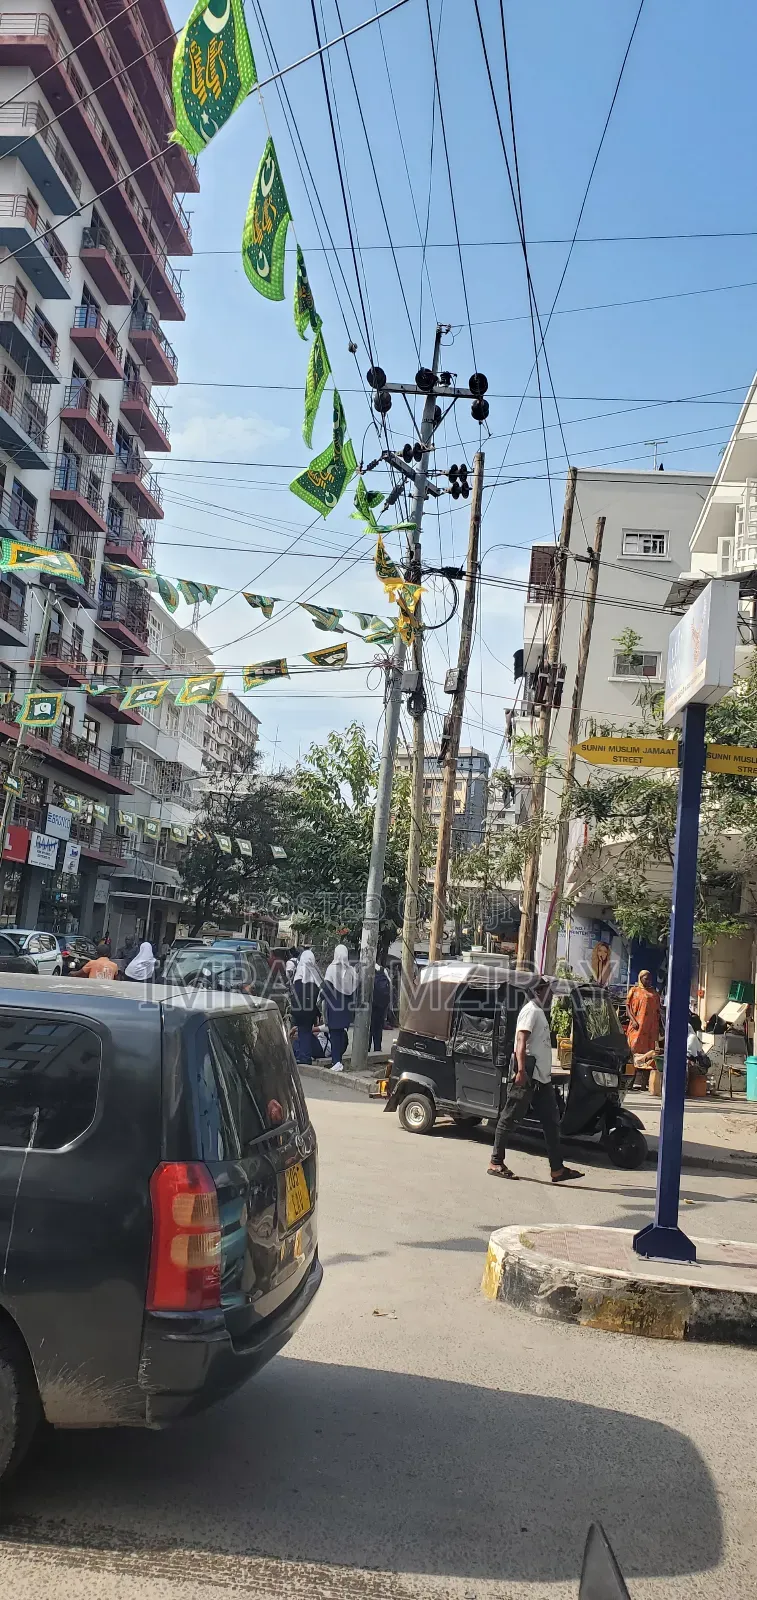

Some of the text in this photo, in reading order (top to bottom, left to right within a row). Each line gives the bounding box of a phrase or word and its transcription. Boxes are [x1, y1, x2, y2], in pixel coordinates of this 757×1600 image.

[581, 744, 676, 755] SUNNI MUSLIM JAMAAT
[612, 755, 644, 764] STREET
[706, 751, 731, 761] SUNNI
